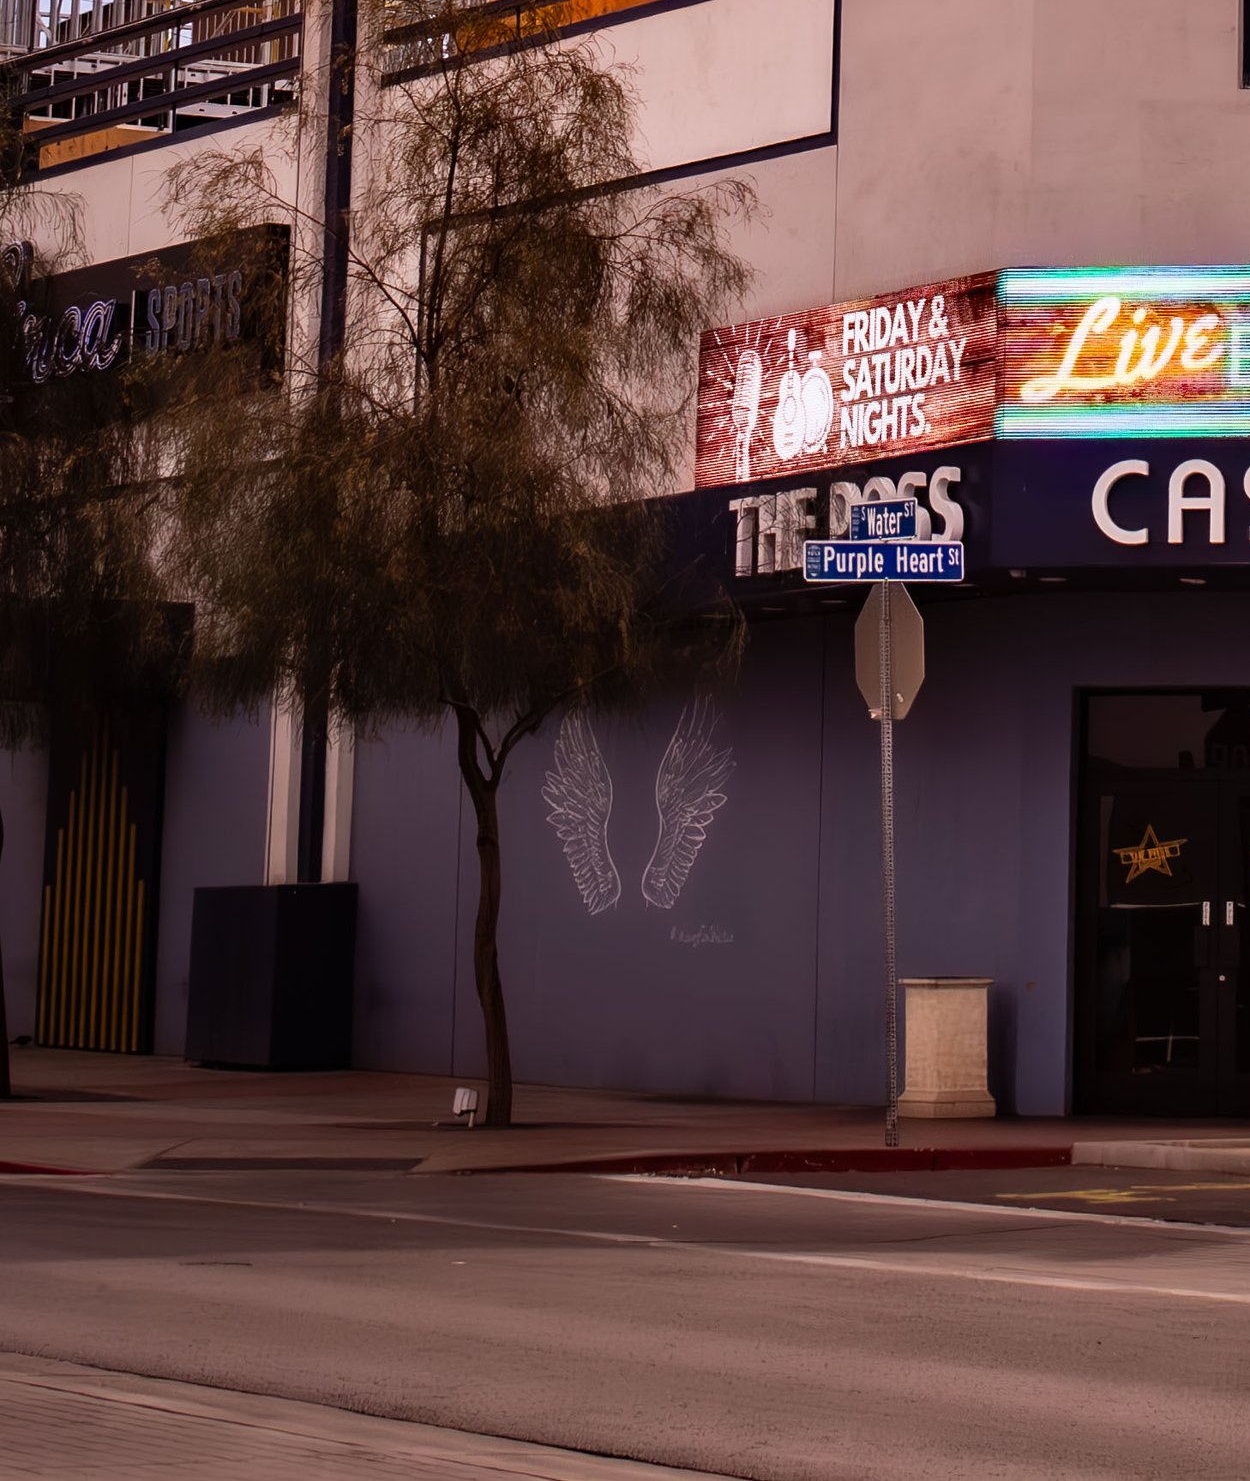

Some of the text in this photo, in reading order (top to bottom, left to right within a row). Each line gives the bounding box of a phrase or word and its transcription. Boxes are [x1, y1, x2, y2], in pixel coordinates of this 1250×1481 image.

[145, 270, 243, 359] SPORTS
[842, 295, 950, 356] FRIDAY &
[841, 338, 968, 402] SATURDAY
[1020, 297, 1225, 402] Live
[839, 393, 932, 448] NIGHTS.
[729, 487, 817, 577] THE
[861, 507, 866, 521] S
[867, 507, 903, 536] Water
[904, 502, 914, 517] ST
[824, 546, 884, 578] Purple
[896, 546, 944, 573] Heart
[948, 548, 960, 565] St
